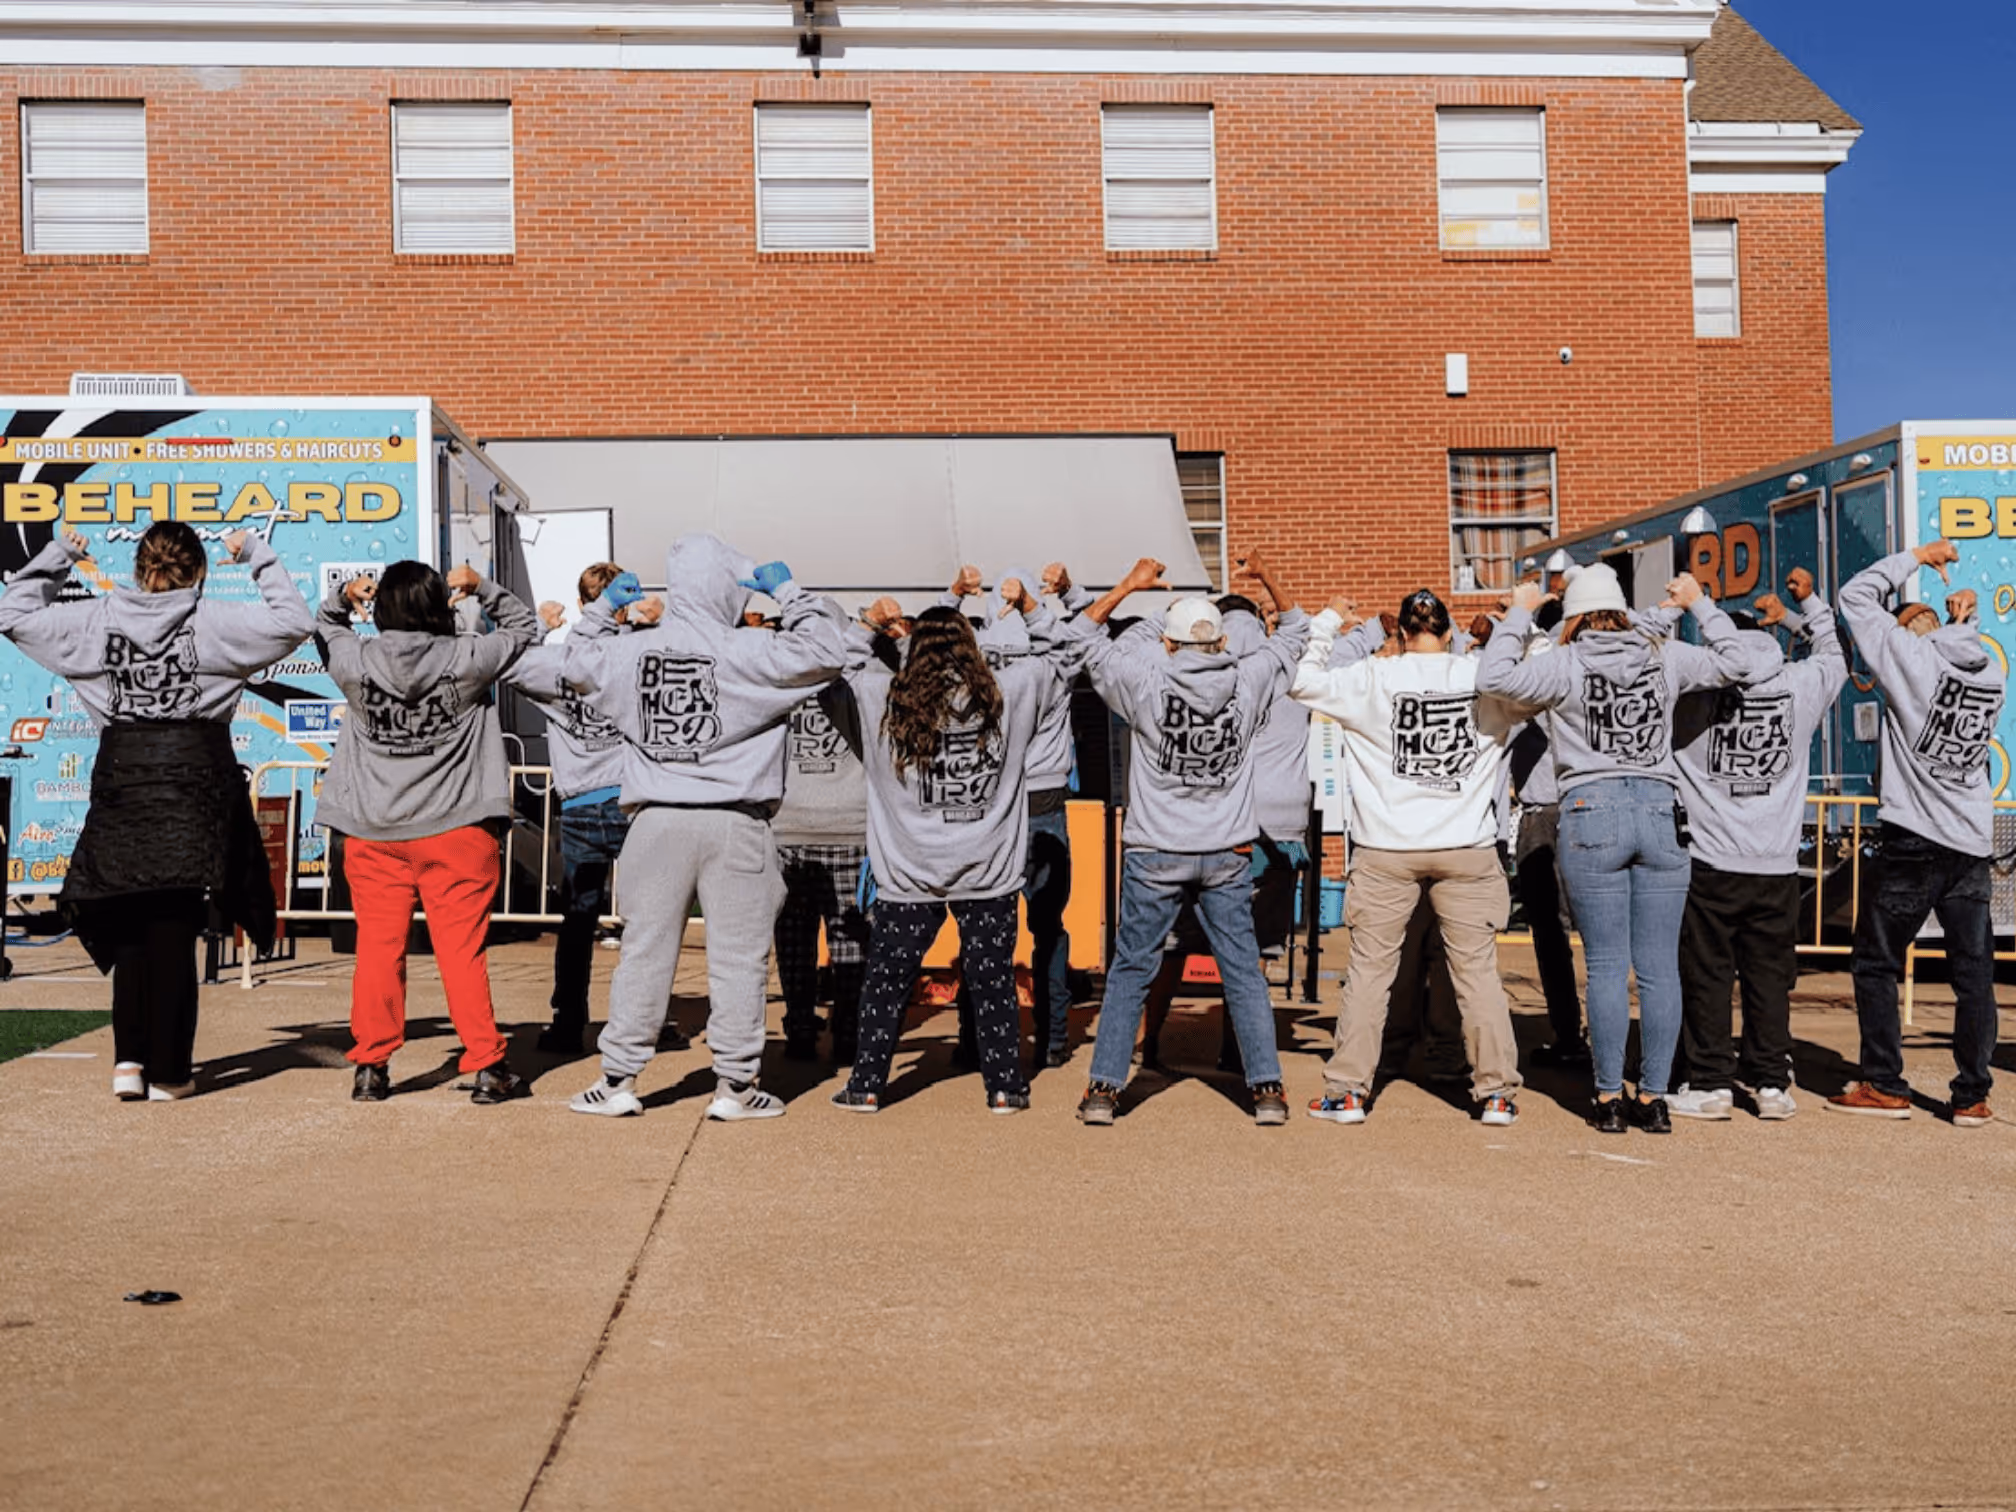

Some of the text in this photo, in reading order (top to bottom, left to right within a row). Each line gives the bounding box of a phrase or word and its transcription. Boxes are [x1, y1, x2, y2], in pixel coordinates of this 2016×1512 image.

[15, 442, 383, 460] MOBILE UNIT FREE SHOWERS & HAIRCUTS
[3, 482, 402, 524] BEHEARD
[641, 655, 712, 688] BE
[1935, 676, 2002, 709] BE
[290, 704, 328, 716] United
[304, 716, 326, 730] Way
[1397, 694, 1478, 730] BE
